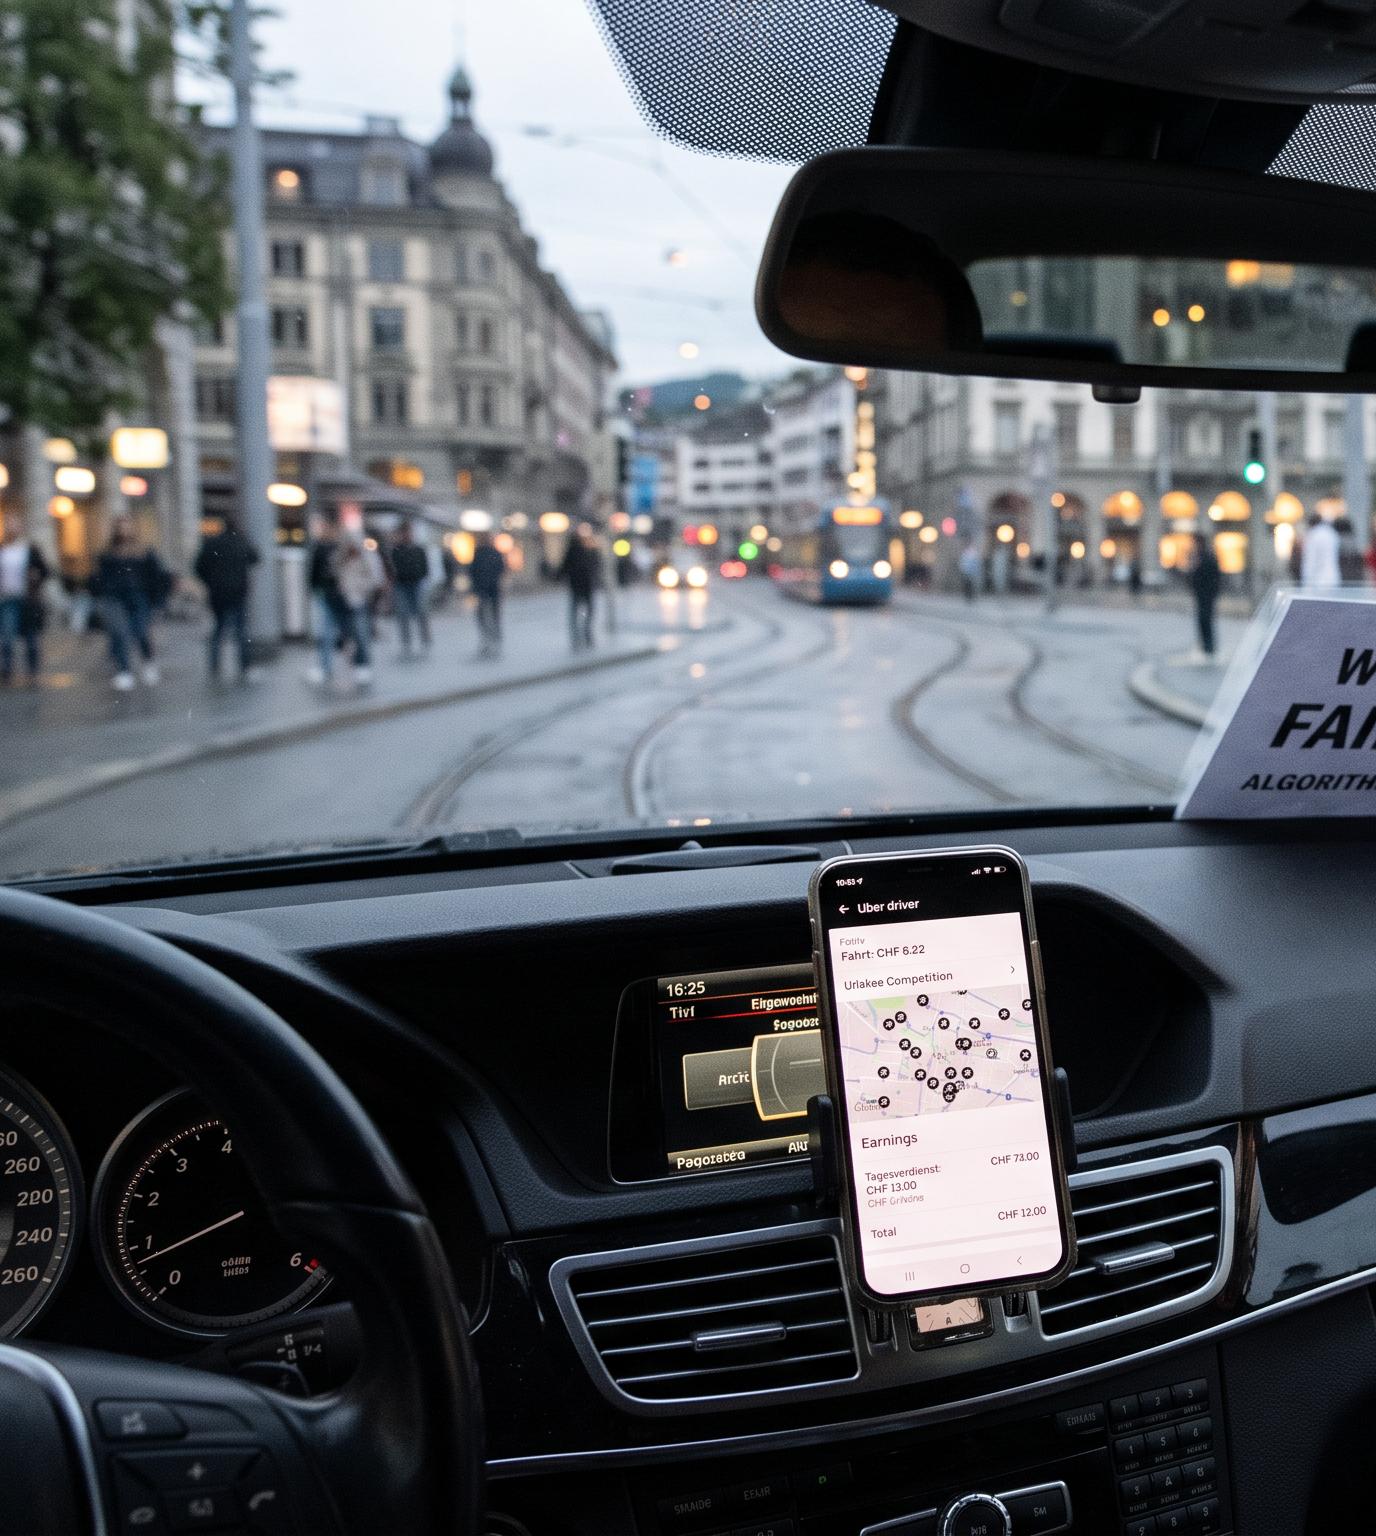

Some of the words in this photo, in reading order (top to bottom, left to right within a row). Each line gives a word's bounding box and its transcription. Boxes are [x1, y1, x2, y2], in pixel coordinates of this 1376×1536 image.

[857, 903, 885, 914] Uber
[887, 900, 920, 911] driver
[841, 950, 874, 961] Fahrt:
[877, 947, 900, 958] CHF
[902, 945, 925, 955] 6.22
[886, 971, 953, 986] Competition
[666, 981, 706, 997] 16:25
[221, 1140, 233, 1154] 4
[861, 1133, 918, 1149] Earnings
[4, 1156, 41, 1175] 260
[176, 1158, 188, 1173] 3
[991, 1155, 1011, 1165] CHF
[1013, 1152, 1039, 1163] 73.00
[866, 1184, 888, 1195] CHF
[891, 1181, 917, 1192] 13.00
[147, 1191, 160, 1207] 2
[868, 1198, 887, 1208] CHF
[998, 1210, 1018, 1220] CHF
[1021, 1206, 1047, 1217] 12.00
[15, 1227, 53, 1247] 240
[871, 1227, 897, 1239] Total
[144, 1235, 153, 1250] 1
[290, 1252, 302, 1267] 6
[1, 1266, 39, 1285] 260
[169, 1270, 181, 1285] 0
